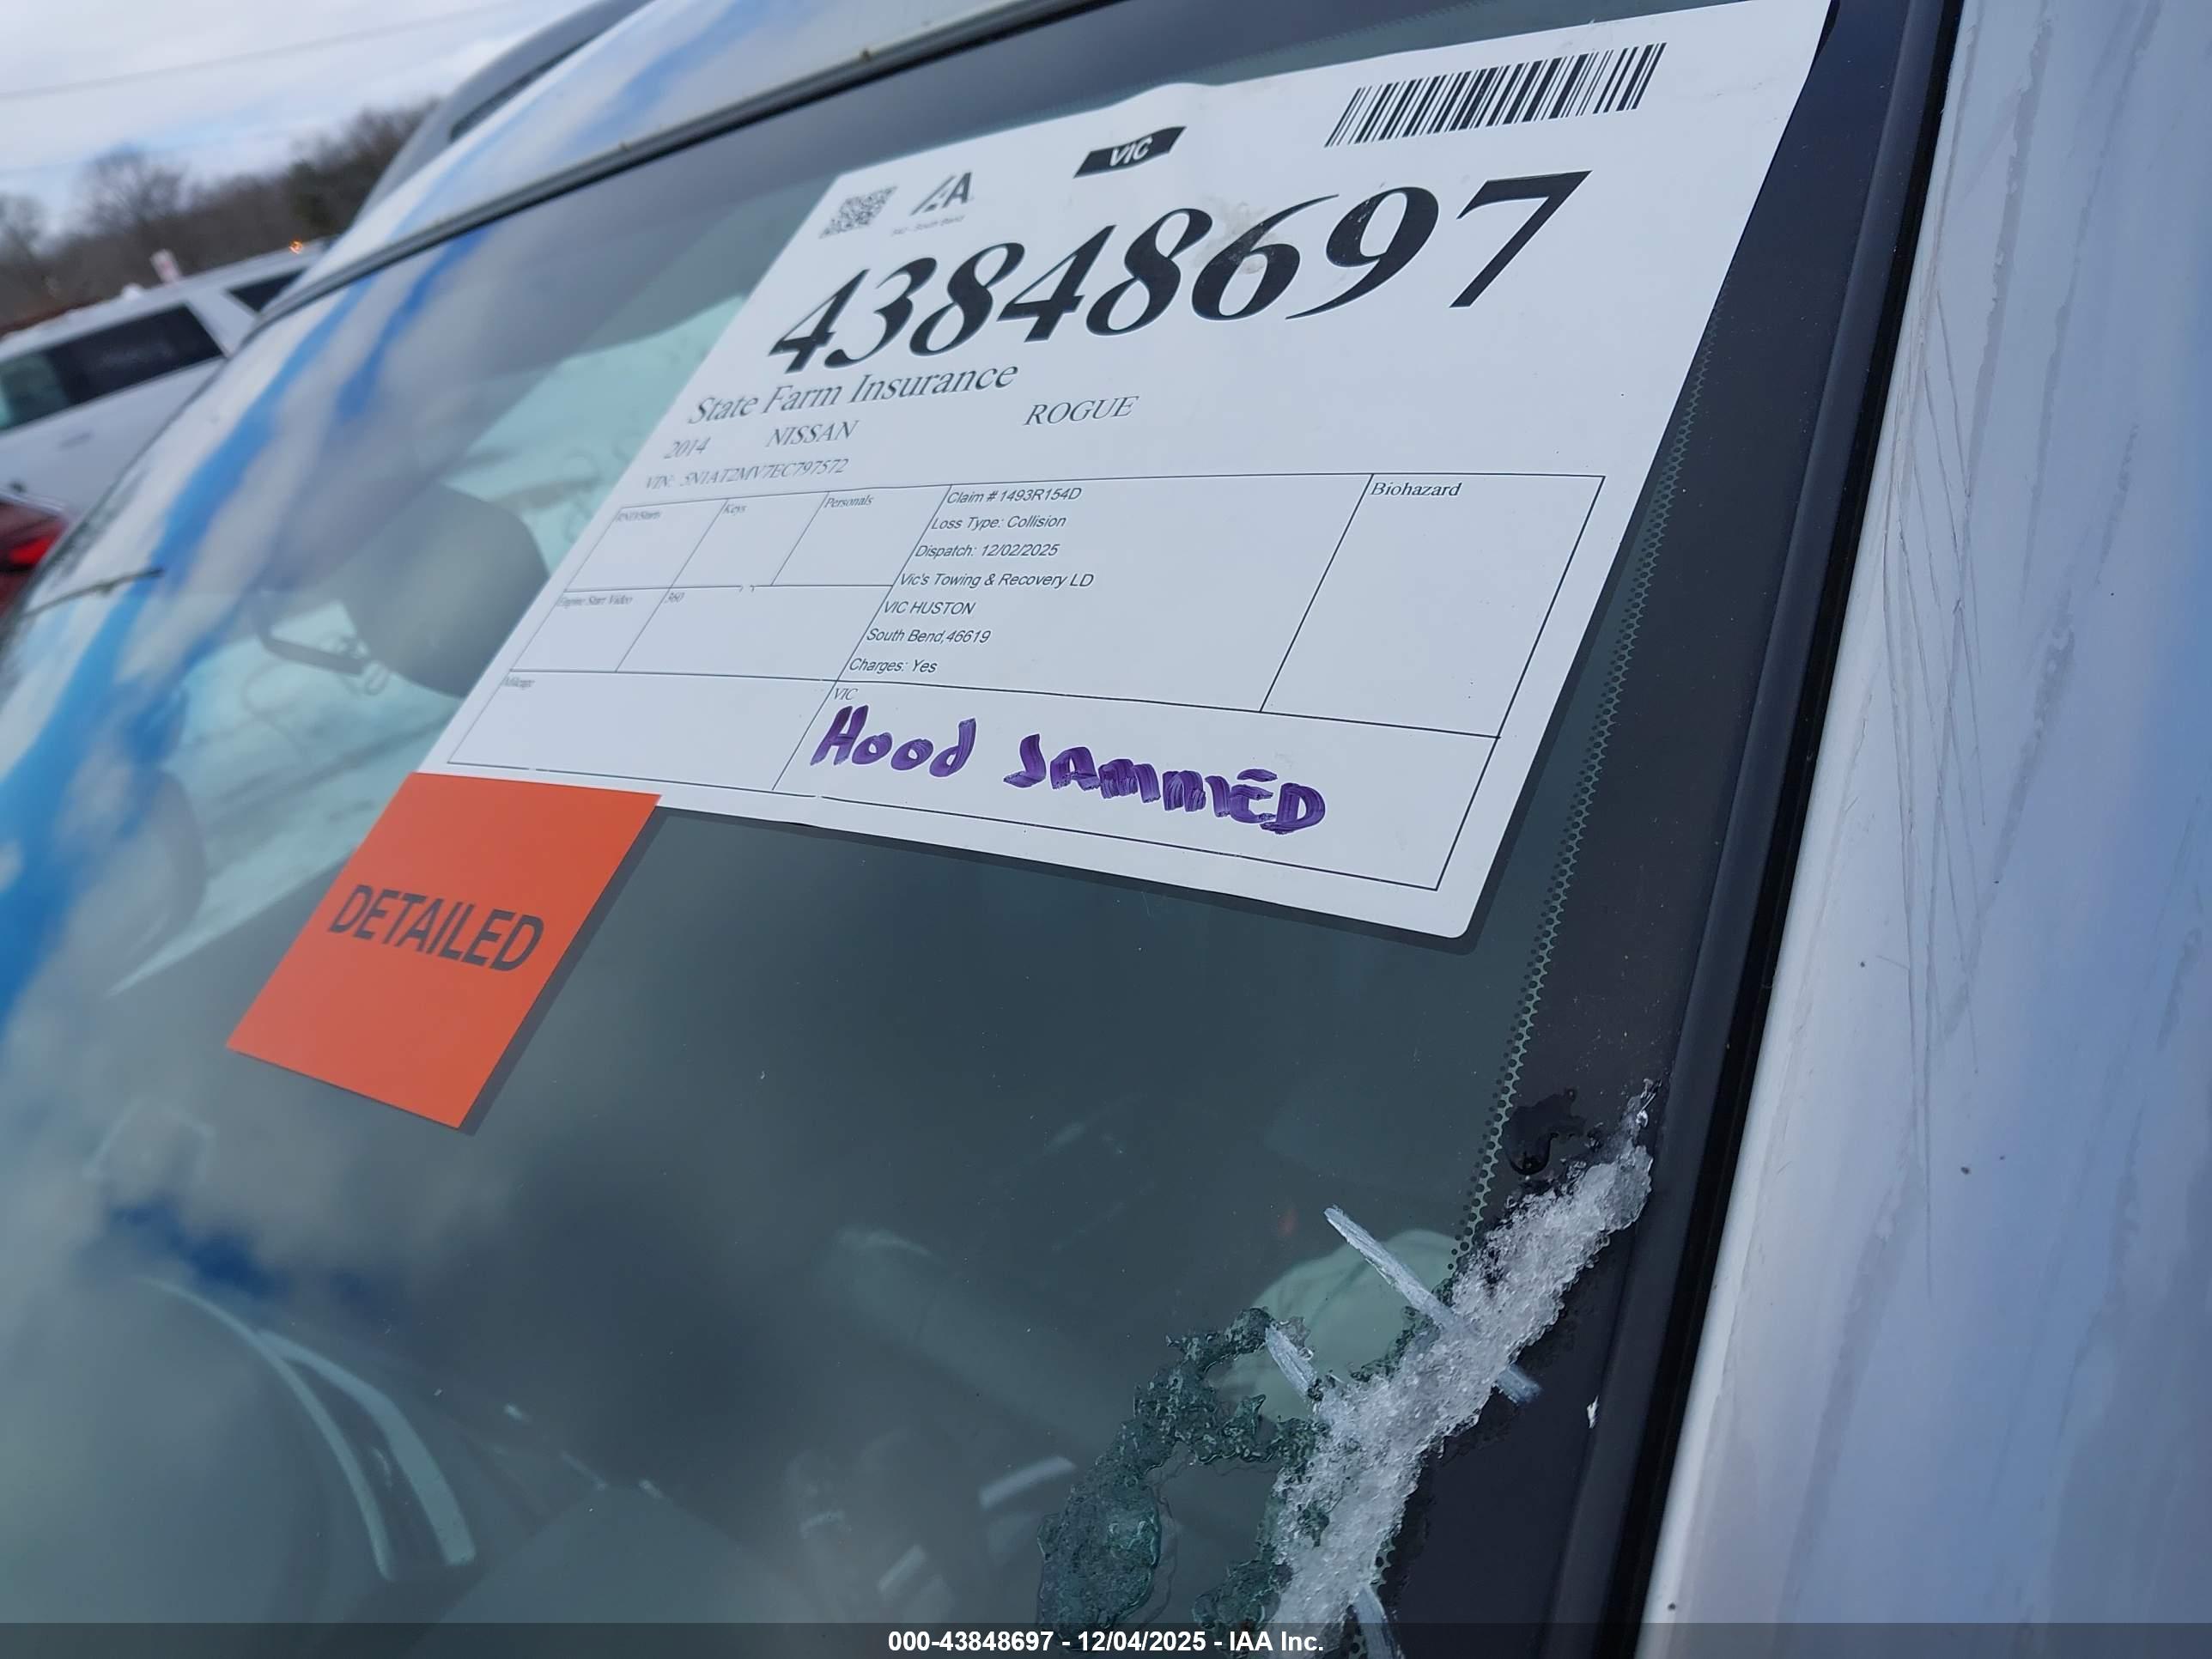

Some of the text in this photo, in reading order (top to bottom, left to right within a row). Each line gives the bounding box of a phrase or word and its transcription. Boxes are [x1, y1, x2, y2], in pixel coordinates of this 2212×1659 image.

[1108, 136, 1153, 167] VIC
[767, 169, 1594, 374] 43848697
[687, 363, 1019, 425] State Farm Insurance
[663, 395, 1138, 460] 2014 NISSAN ROGUE
[946, 487, 1083, 505] Claim # 1493R154D
[1371, 482, 1462, 496] Biohazard
[722, 503, 748, 516] Keys
[824, 495, 874, 508] Personals
[932, 515, 1067, 532] Loss Type: Collision
[915, 544, 1061, 560] Dispatch: 12/02/2025
[900, 573, 1096, 589] Vic's Towing & Recovery LD
[883, 602, 976, 616] VIC HUSTON
[866, 629, 904, 643] South
[848, 659, 938, 675] Charges: Yes
[833, 688, 859, 702] VIC
[811, 705, 976, 777] Hood
[327, 884, 545, 972] DETAILED
